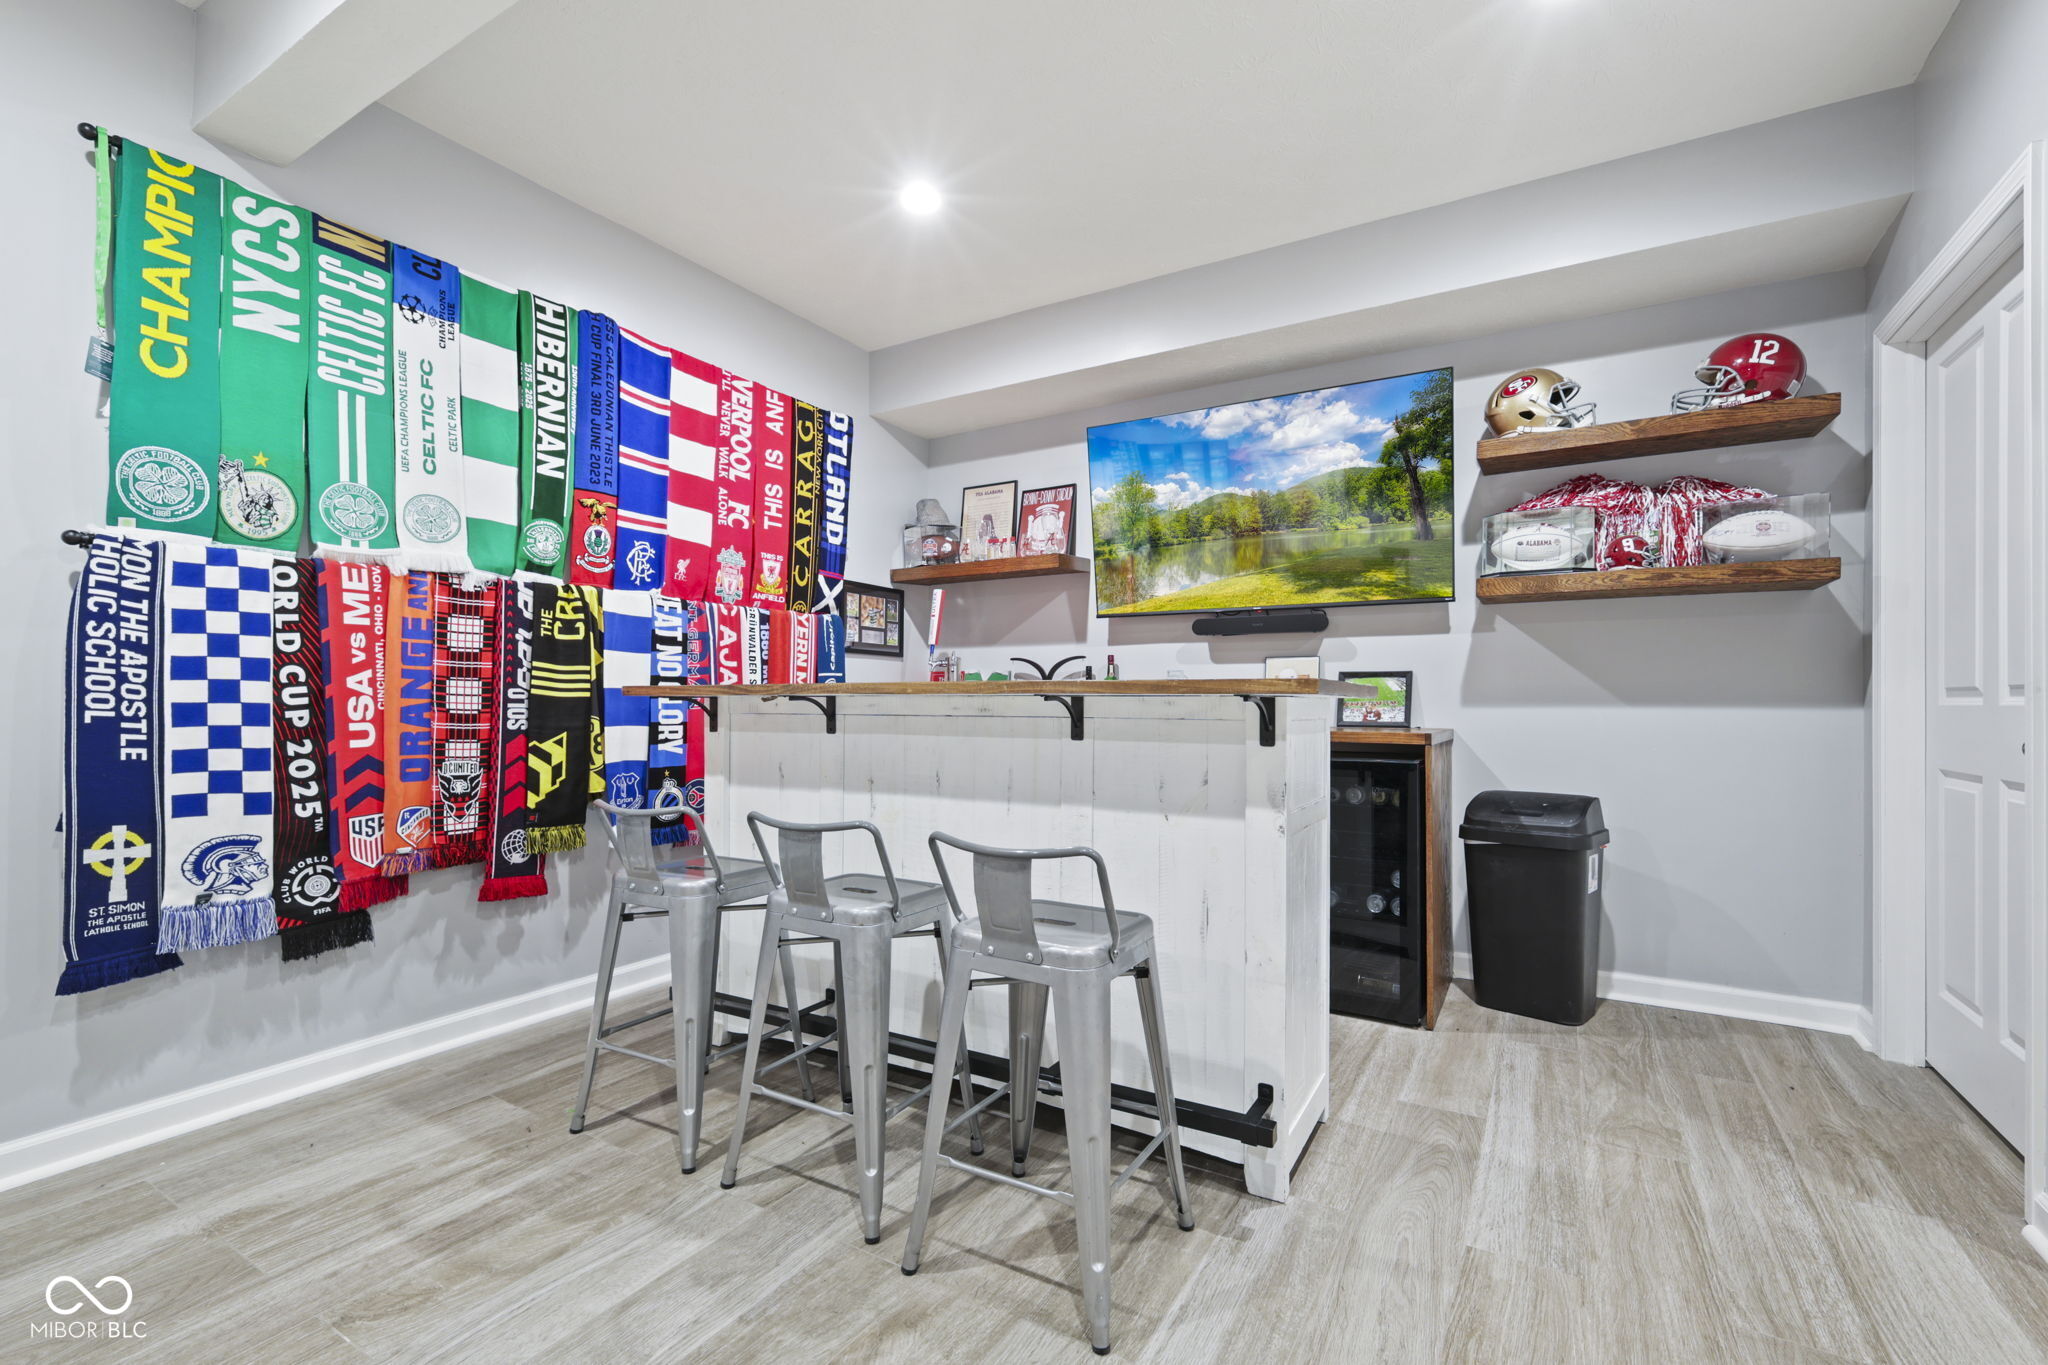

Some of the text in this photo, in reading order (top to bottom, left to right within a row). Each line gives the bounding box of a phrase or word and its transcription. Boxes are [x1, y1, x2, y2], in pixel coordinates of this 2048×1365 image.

[231, 196, 300, 343] NYCS
[318, 254, 386, 294] FC
[438, 289, 447, 349] CHAMPIONS
[447, 302, 455, 341] LEAGUE
[591, 325, 601, 349] CUP
[317, 294, 386, 395] CELTIC
[1749, 339, 1780, 365] 12
[524, 362, 533, 382] 1875
[533, 294, 568, 479] HIBERNIAN
[591, 352, 601, 387] FINAL
[604, 346, 615, 431] CALEDONIAN
[398, 349, 410, 473] UEFA CHAMPIONS LEAGUE
[419, 358, 437, 475] CELTIC FC
[524, 388, 533, 409] 2025
[591, 391, 601, 416] 3RD
[446, 396, 458, 453] CELTIC PARK
[590, 418, 601, 451] JUNE
[719, 400, 731, 437] NEVER
[729, 377, 754, 482] VERPOOL
[589, 453, 600, 485] 2023
[603, 436, 613, 488] THISTLE
[718, 446, 729, 478] WALK
[763, 390, 786, 530] THIS IS ANF
[815, 464, 823, 494] NEW
[718, 486, 728, 525] ALONE
[727, 499, 750, 530] FC
[247, 527, 269, 536] 1995
[1525, 539, 1552, 547] ALABAMA
[760, 552, 776, 560] THIS
[273, 558, 300, 653] ORLD
[752, 592, 785, 603] ANFIELD
[122, 597, 149, 645] THE
[375, 603, 384, 635] OHIO
[540, 609, 553, 637] THE
[351, 632, 367, 663] vs
[84, 623, 116, 724] SCHOOL
[375, 638, 385, 711] CINCINNATI,
[653, 592, 684, 755] EAT NO LORY
[120, 649, 148, 761] APOSTLE
[279, 665, 310, 729] CUP
[347, 668, 376, 749] USA
[399, 616, 433, 782] ORANGE
[506, 688, 528, 731] SOLO
[453, 762, 478, 774] UNITED
[281, 855, 328, 904] CLUB WORLD
[83, 919, 149, 937] CATHOLIC SCHOOL
[86, 912, 147, 927] THE APOSTLE
[109, 902, 146, 917] SIMON
[313, 906, 332, 915] FIFA
